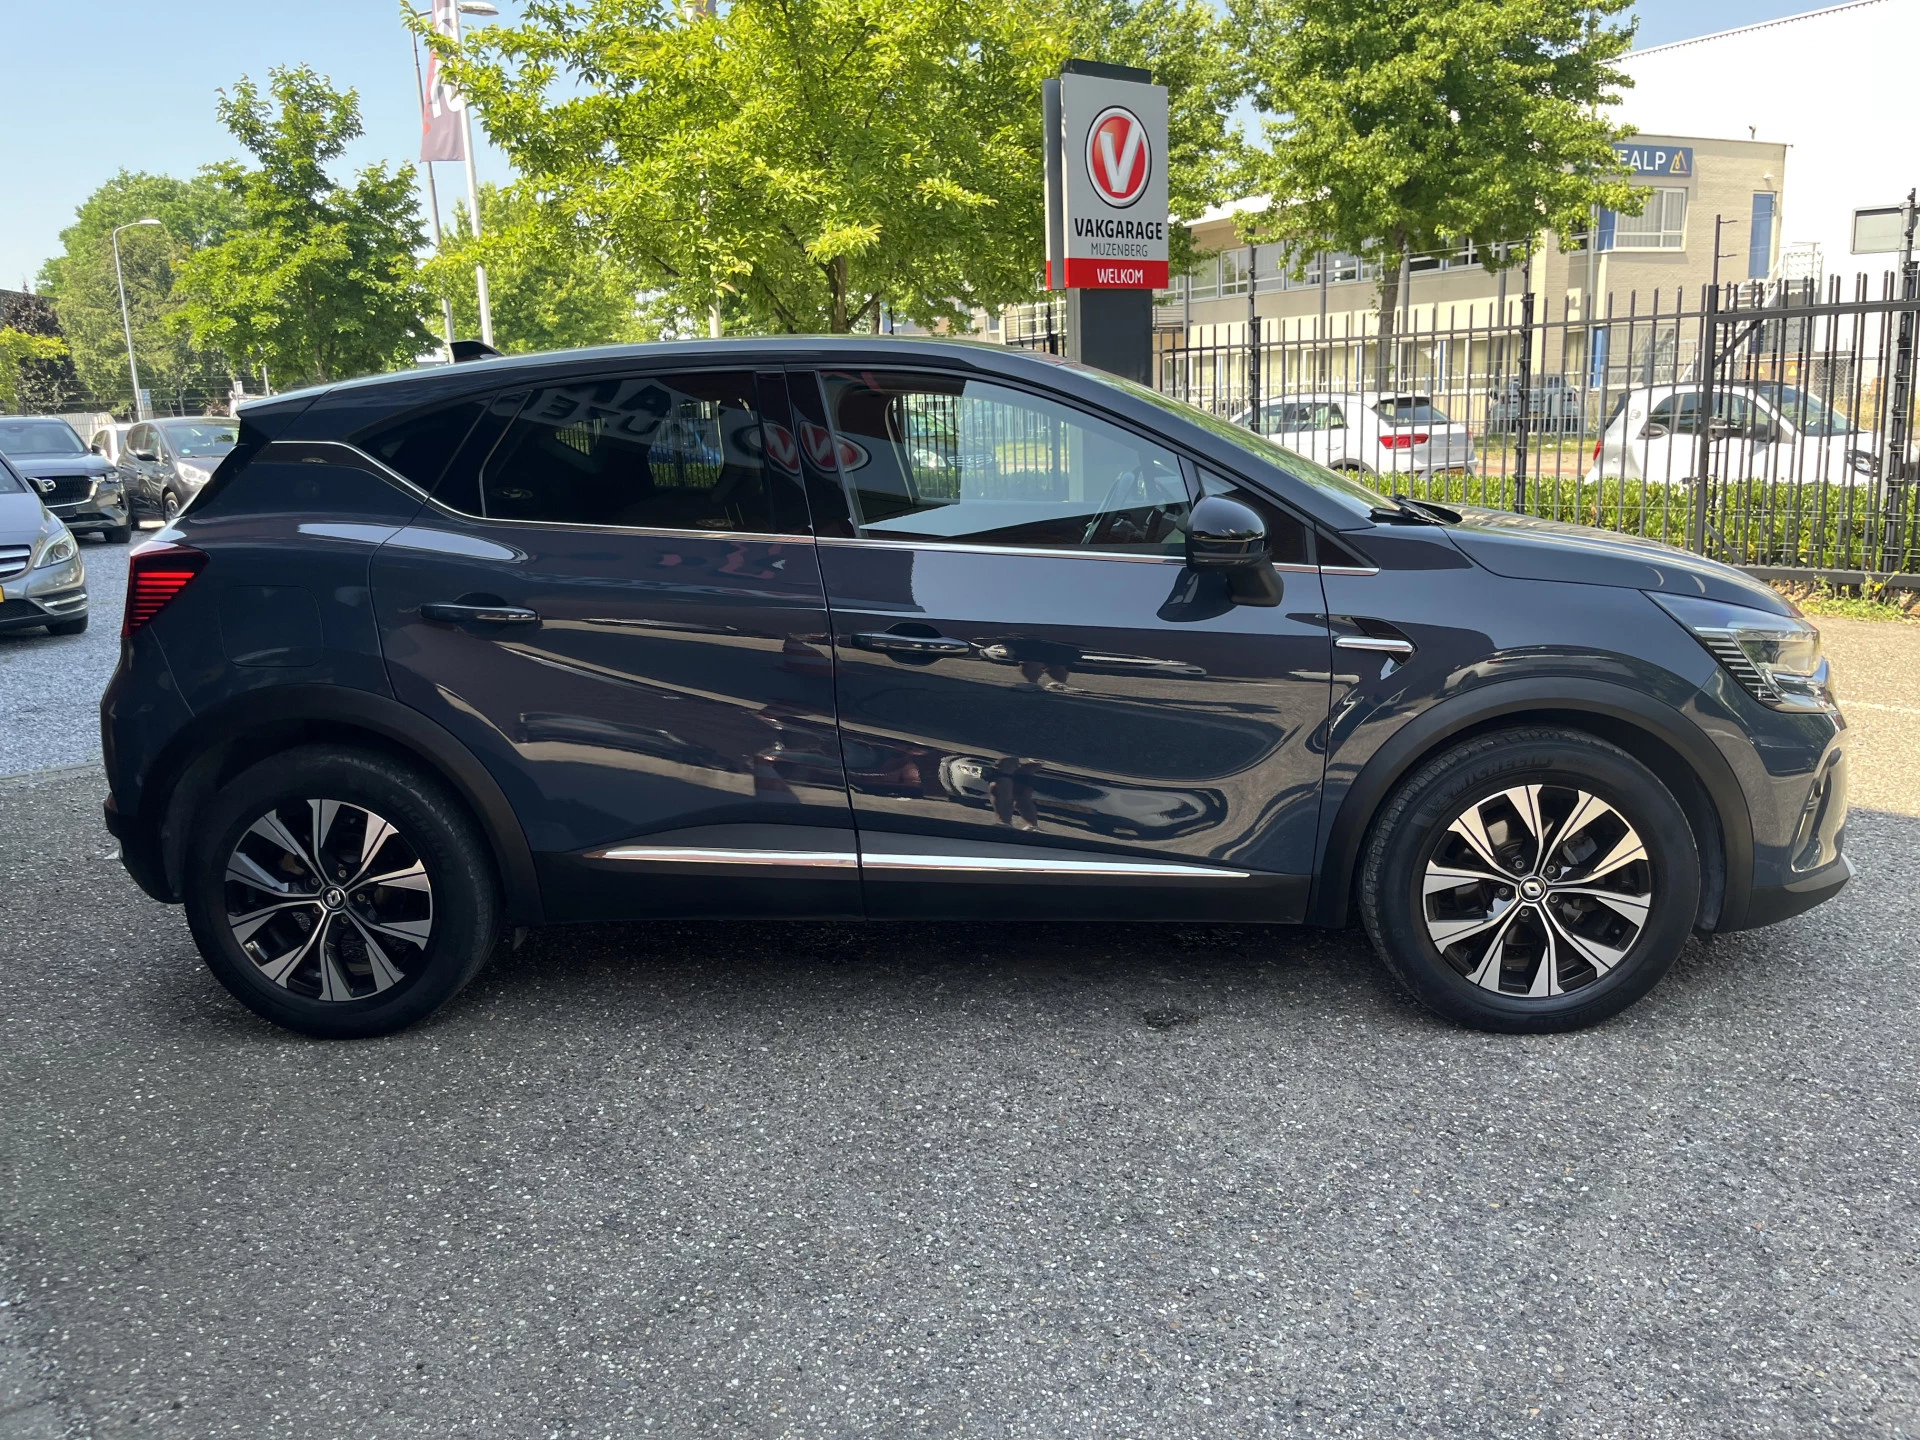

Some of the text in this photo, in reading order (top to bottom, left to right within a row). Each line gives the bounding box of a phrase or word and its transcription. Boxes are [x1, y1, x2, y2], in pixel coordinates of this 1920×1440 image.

[1097, 115, 1145, 194] V
[1074, 217, 1163, 241] VAKGARAGE
[1090, 242, 1148, 258] MUZENBERG
[1096, 267, 1144, 285] WELKOM
[1450, 755, 1555, 797] MICHELIN
